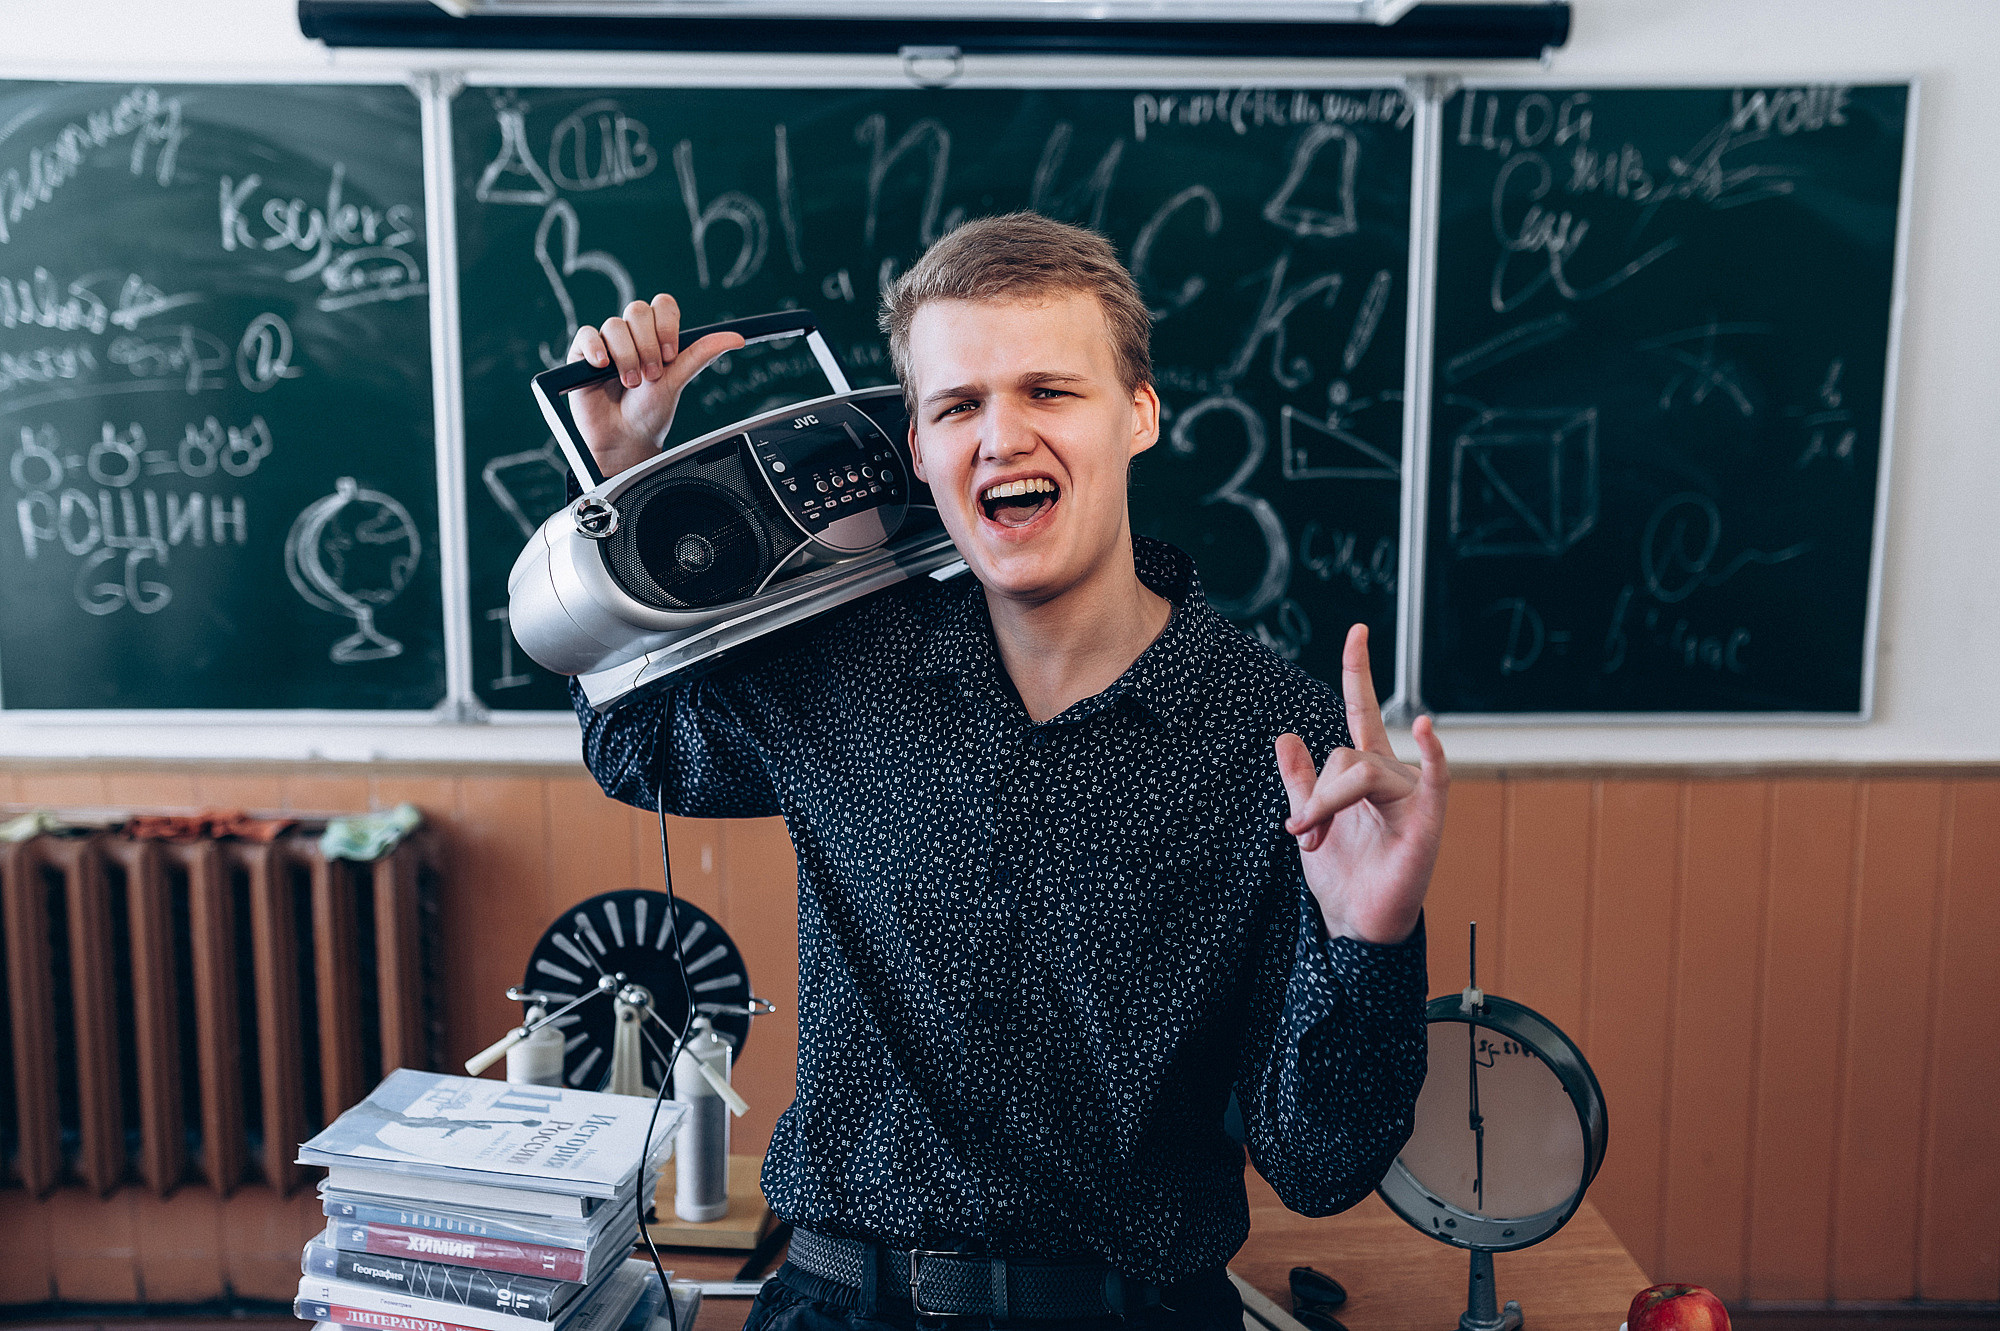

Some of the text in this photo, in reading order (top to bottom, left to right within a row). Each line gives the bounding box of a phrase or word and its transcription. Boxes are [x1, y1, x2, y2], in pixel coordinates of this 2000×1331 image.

[794, 414, 819, 430] JVC
[507, 1119, 573, 1164] России
[543, 1113, 617, 1168] История
[406, 1235, 556, 1271] ХИМИЯ 11
[351, 1262, 404, 1282] География
[380, 1297, 413, 1310] Геометрия
[345, 1309, 447, 1331] ЛИТЕРАТУРА
